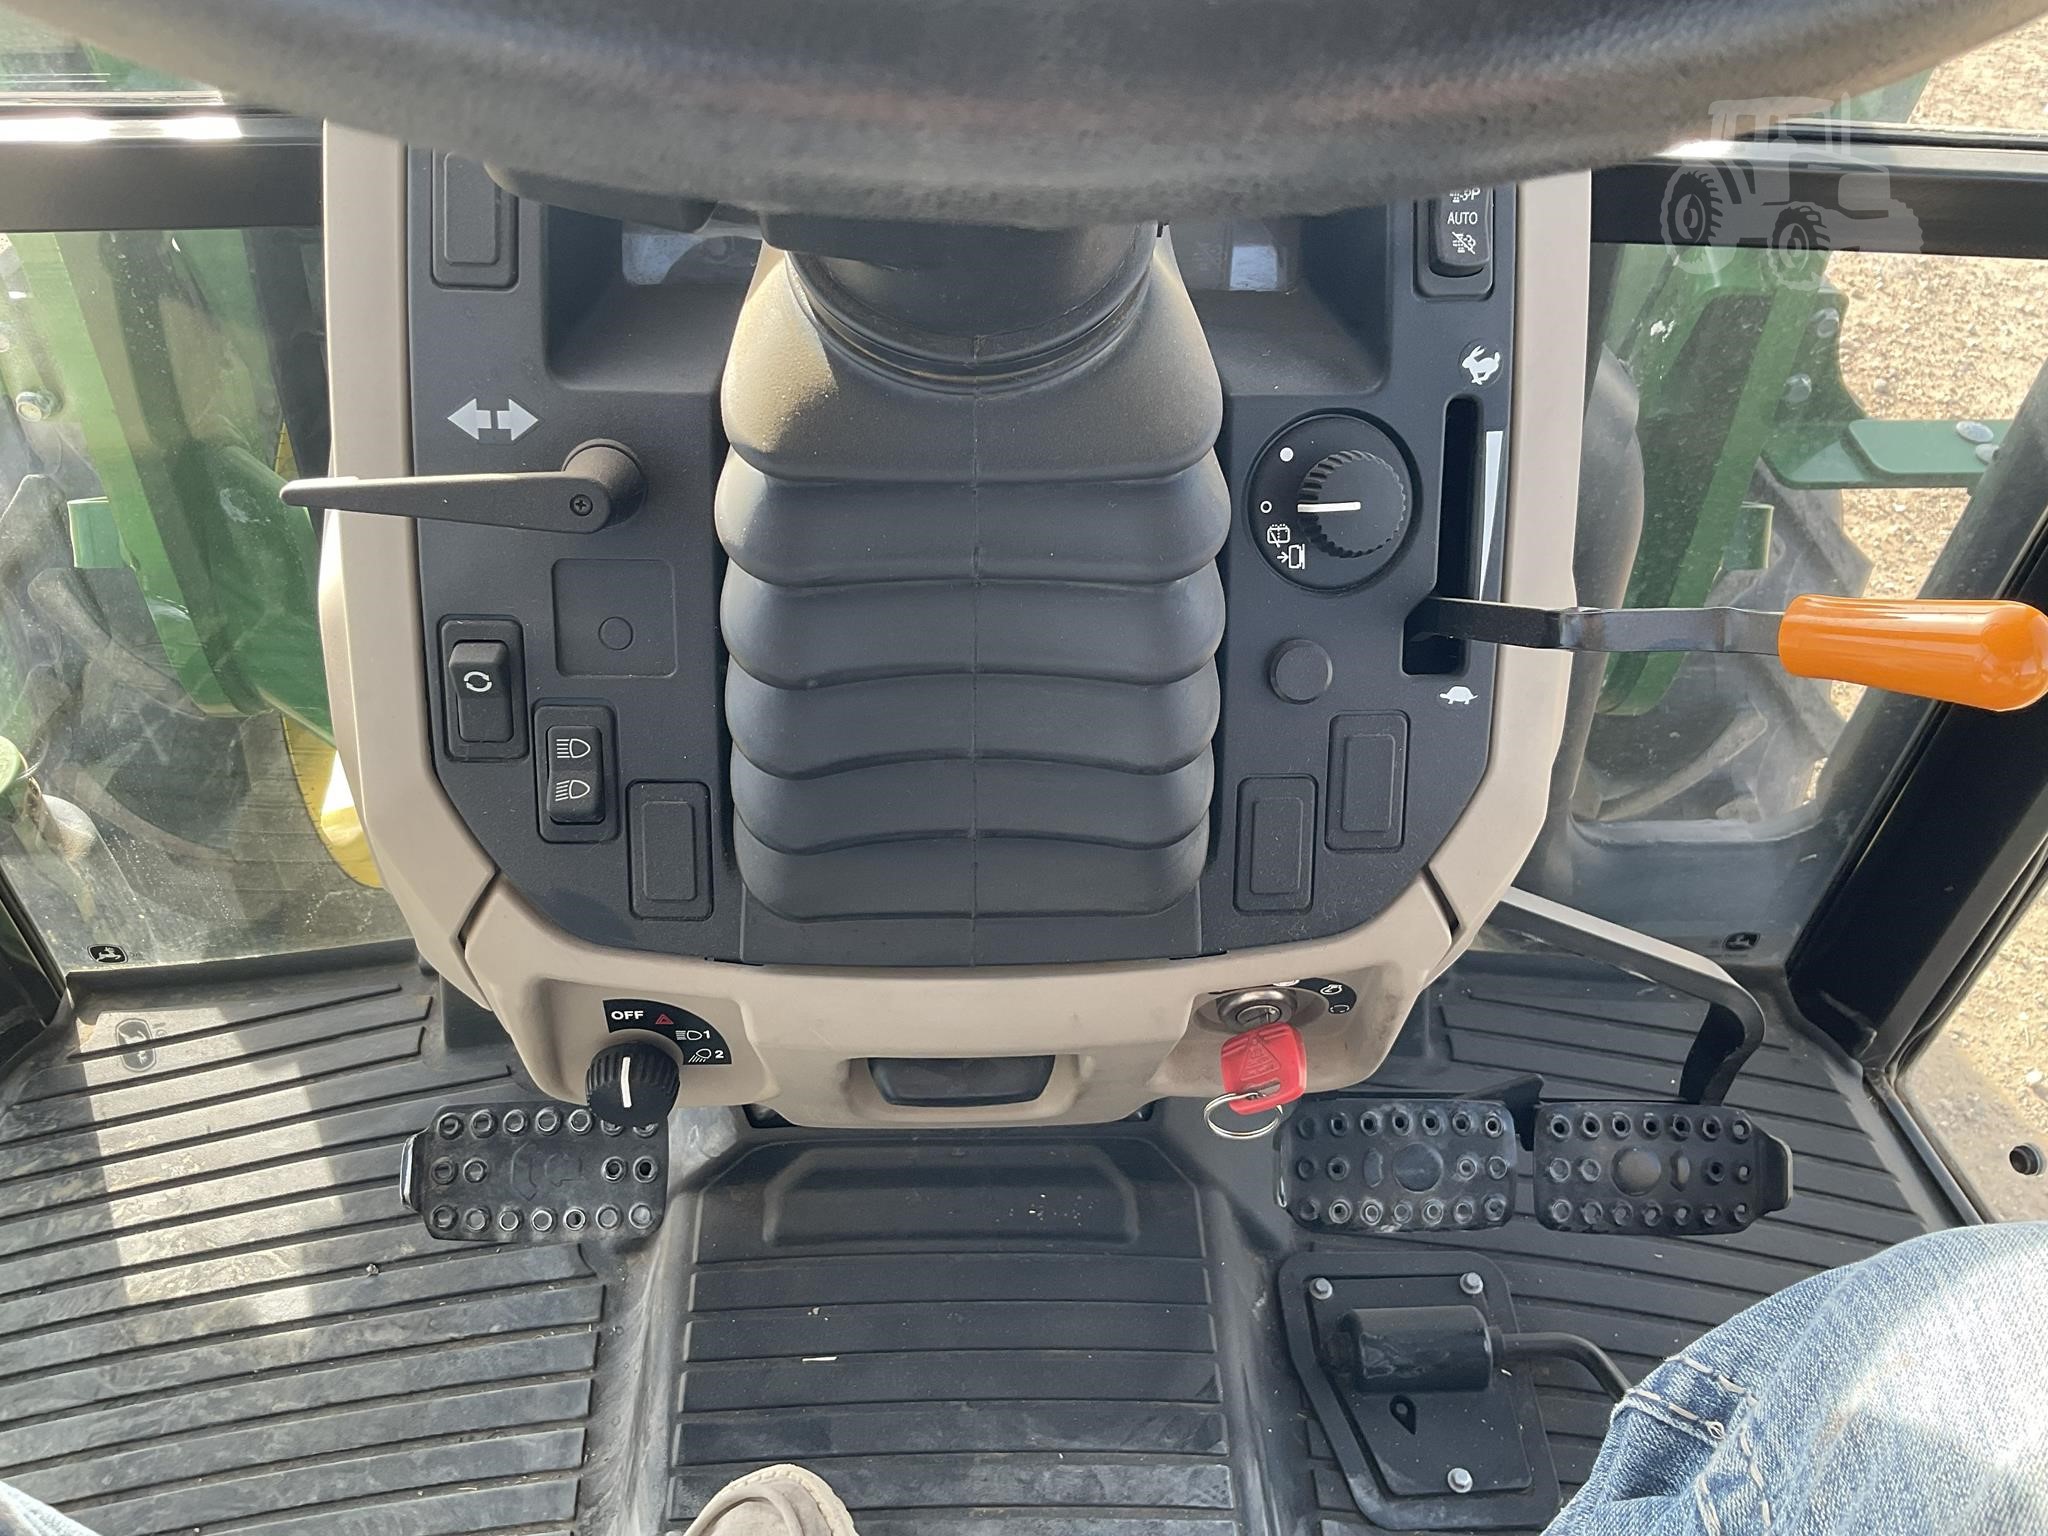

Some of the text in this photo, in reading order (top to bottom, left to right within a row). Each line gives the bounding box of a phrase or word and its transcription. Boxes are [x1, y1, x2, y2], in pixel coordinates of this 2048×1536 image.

[1447, 211, 1478, 225] AUTO
[611, 1010, 644, 1020] OFF
[703, 1030, 711, 1039] 1
[714, 1050, 724, 1059] 2
